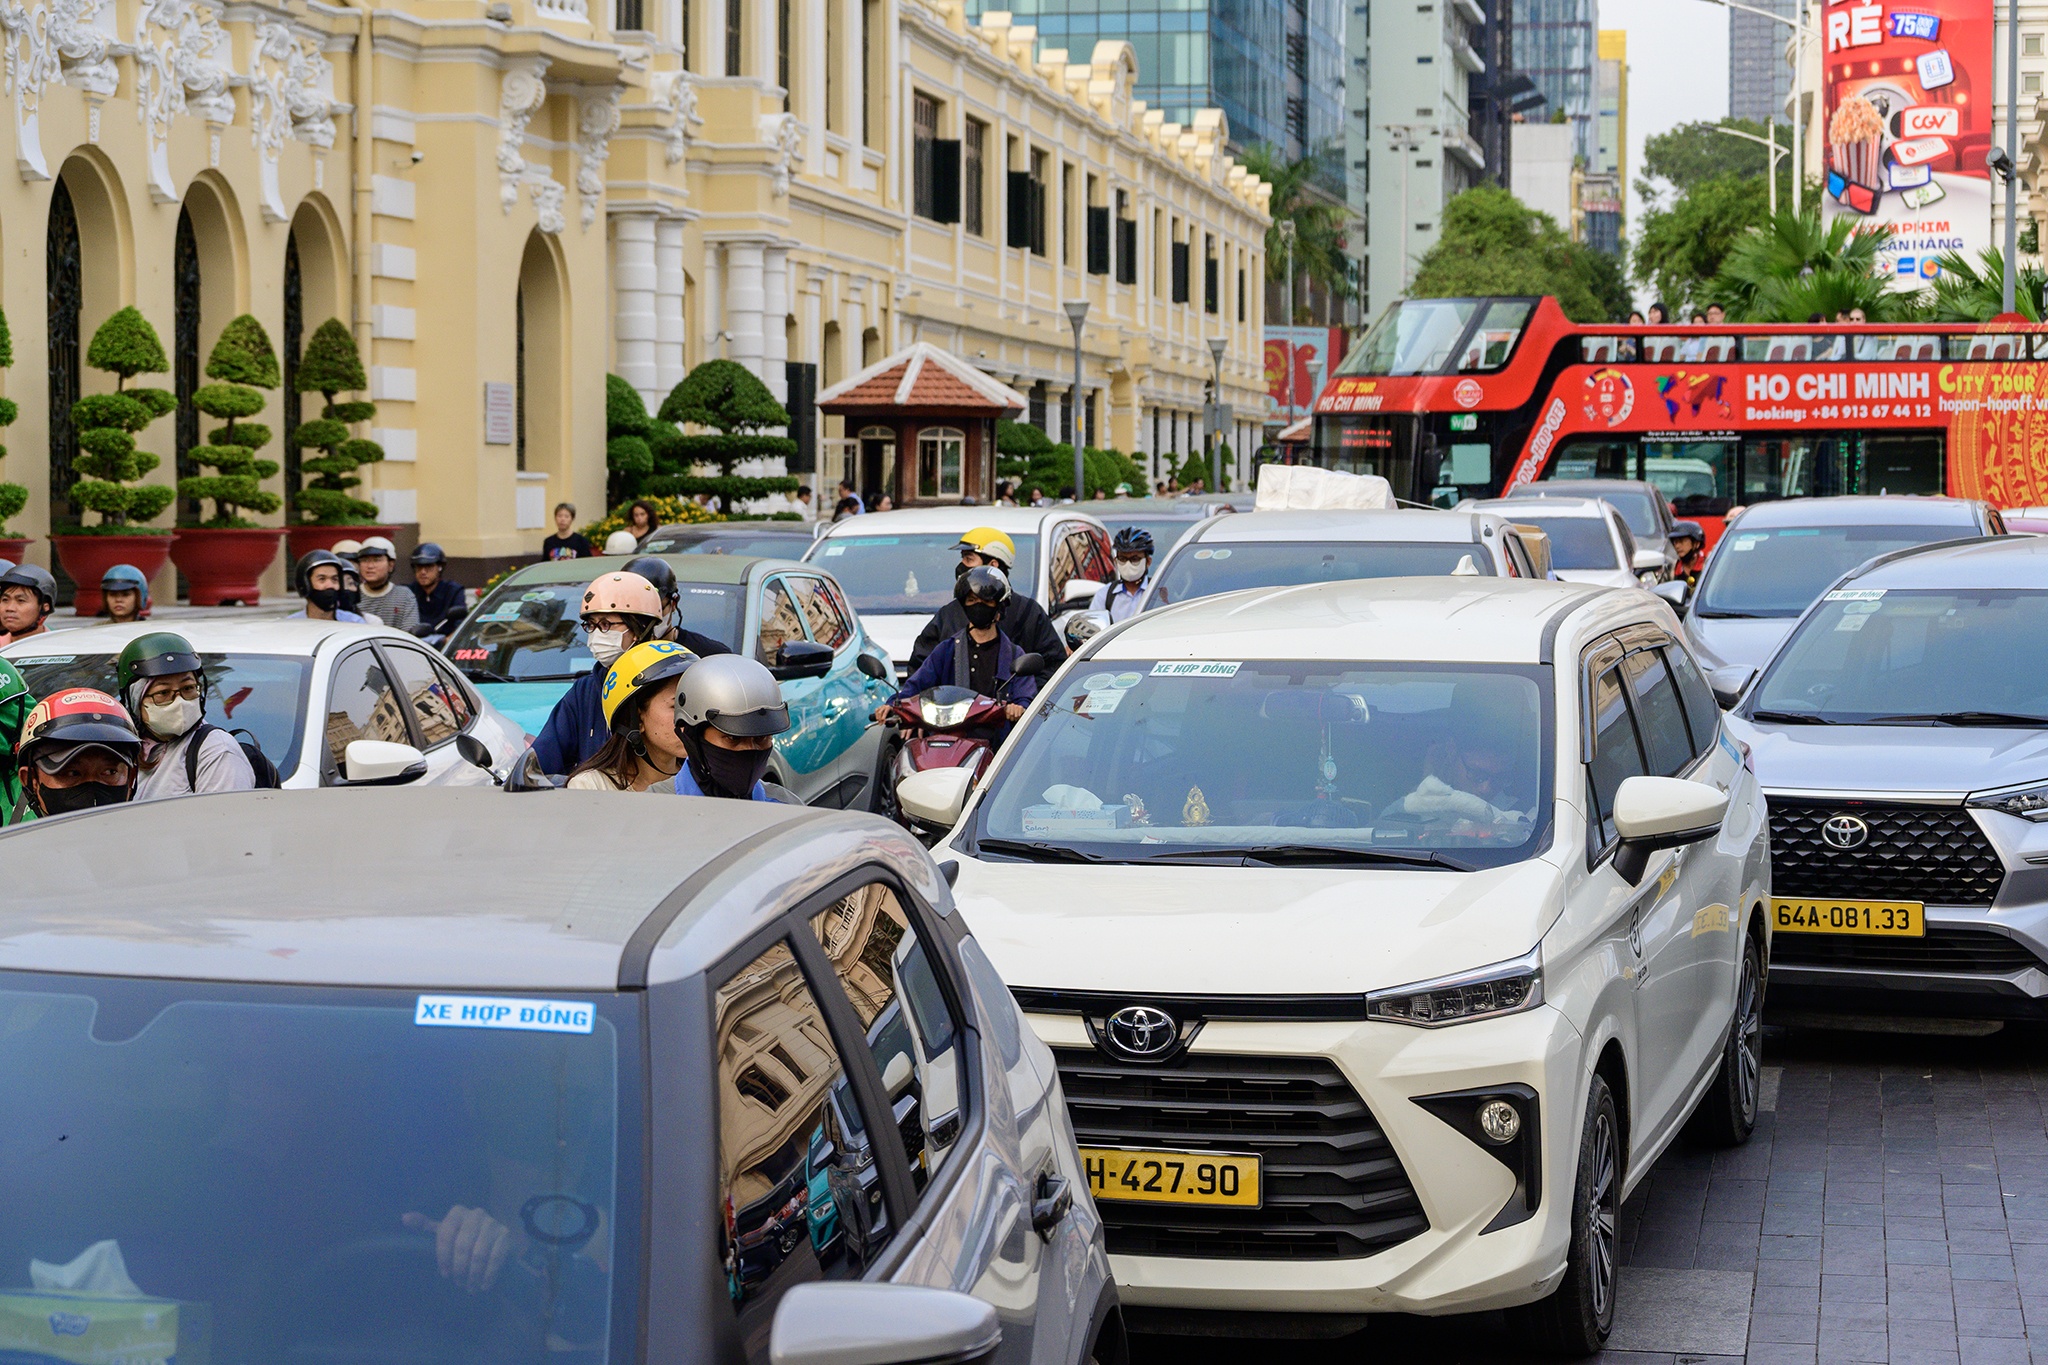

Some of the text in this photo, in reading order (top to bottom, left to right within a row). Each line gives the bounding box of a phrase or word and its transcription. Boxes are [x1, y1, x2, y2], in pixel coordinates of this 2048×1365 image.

[1894, 14, 1917, 35] 75
[1912, 115, 1947, 130] CGV
[1902, 221, 1950, 234] PHIM
[1913, 236, 1964, 251] HÀNG
[1746, 372, 1930, 400] HO CHI MINH
[1938, 364, 2036, 393] CITY TOUR
[1319, 395, 1384, 411] HO CHI MINH
[1548, 399, 1566, 432] OFF
[1746, 404, 1931, 422] Booking: +84 913 67 44 12
[455, 648, 489, 660] TAXI
[1153, 664, 1172, 673] XE
[1173, 663, 1199, 675] HỢP
[1778, 904, 1910, 930] 64A-081.33
[421, 1003, 588, 1026] XE HỢP ĐỒNG
